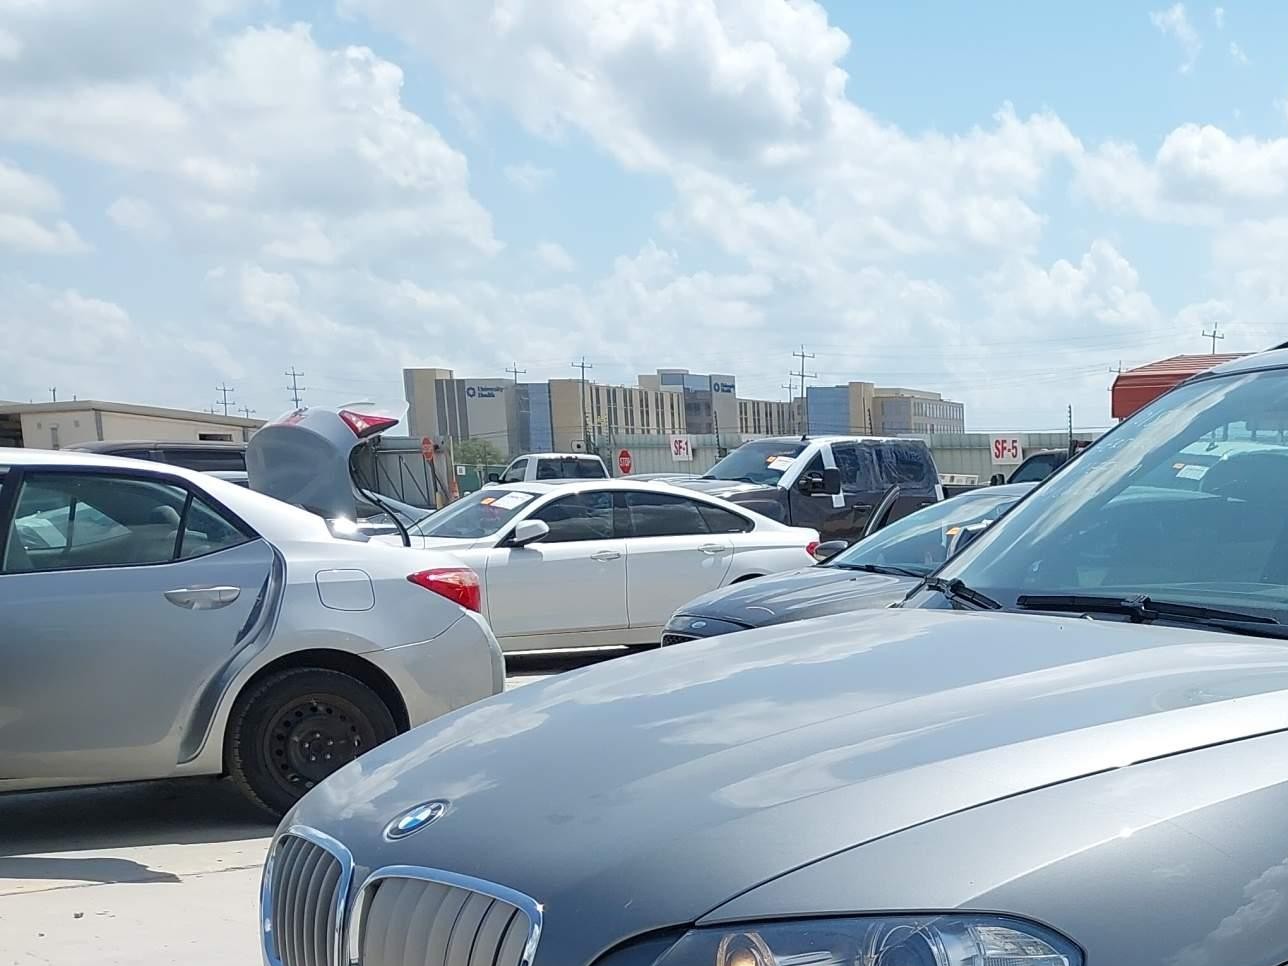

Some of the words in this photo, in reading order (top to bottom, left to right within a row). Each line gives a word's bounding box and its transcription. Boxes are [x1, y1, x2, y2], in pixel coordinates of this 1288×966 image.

[673, 439, 689, 456] SF-1
[994, 439, 1018, 459] SF-5
[619, 457, 631, 467] STOP
